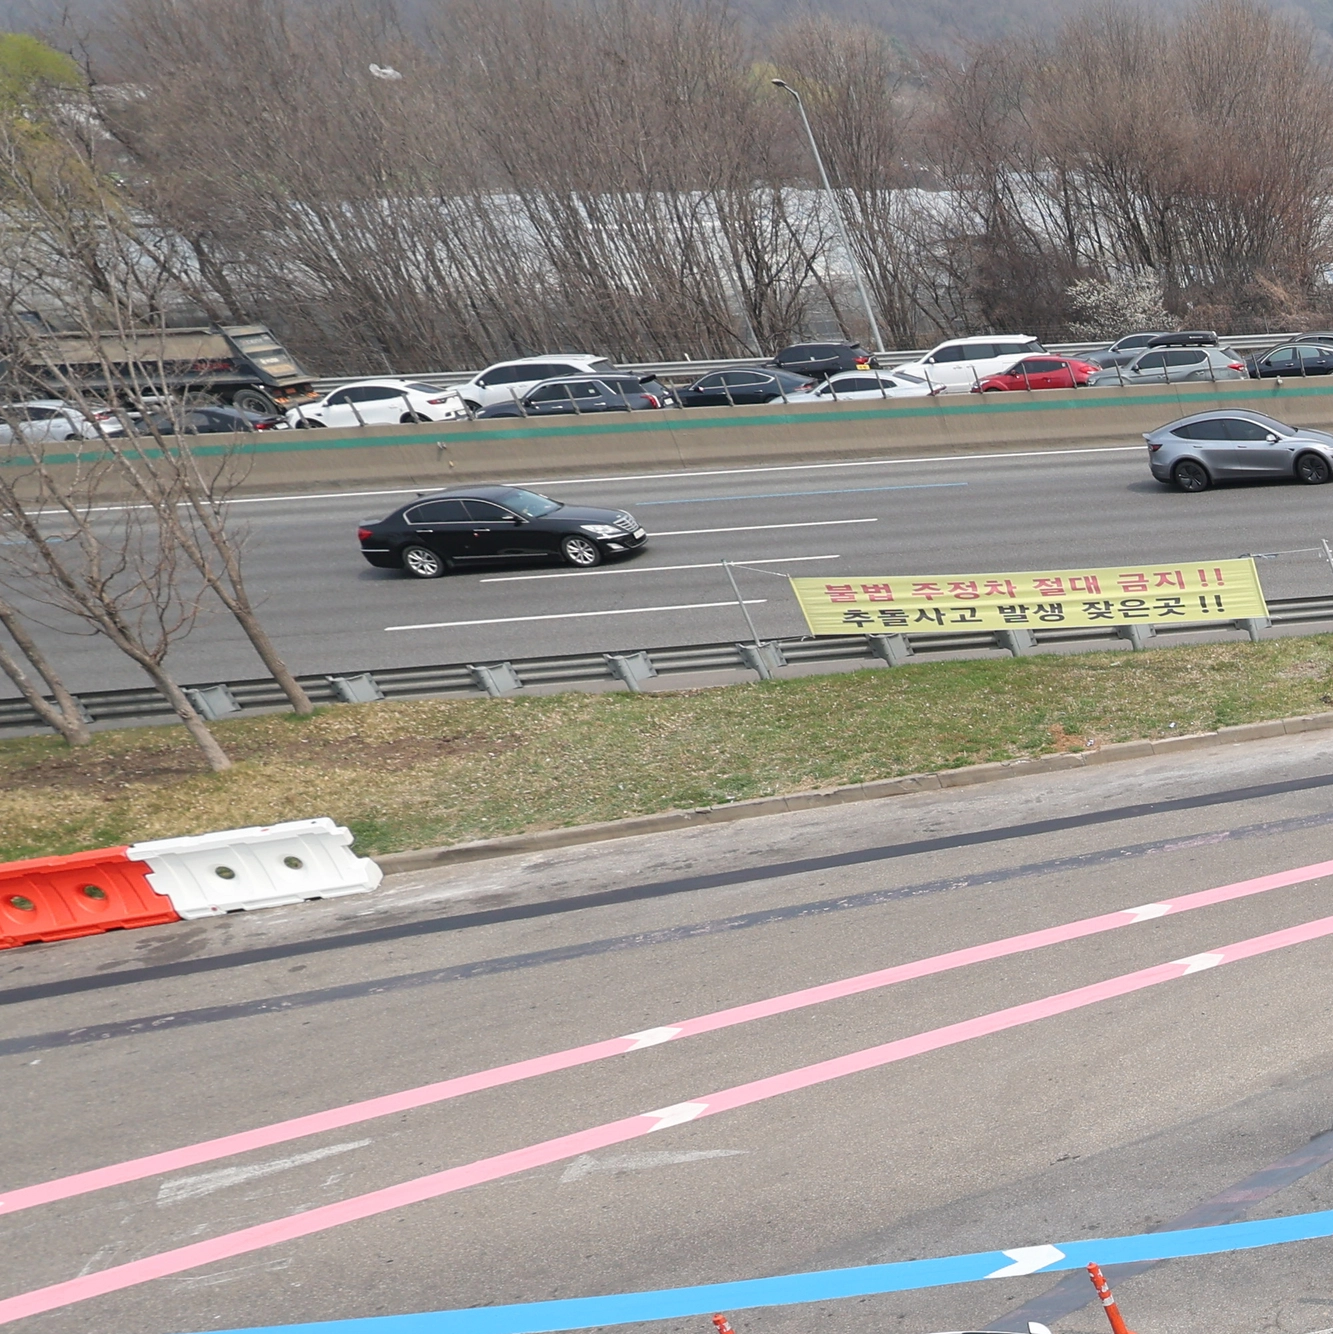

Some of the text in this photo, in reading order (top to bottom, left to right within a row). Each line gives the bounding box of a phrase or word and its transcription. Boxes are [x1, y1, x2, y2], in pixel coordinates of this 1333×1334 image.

[824, 567, 1225, 604] 불법 주정차 절대 금지 !!
[842, 594, 1224, 629] 추돌사고 발생 잦은곳 !!
